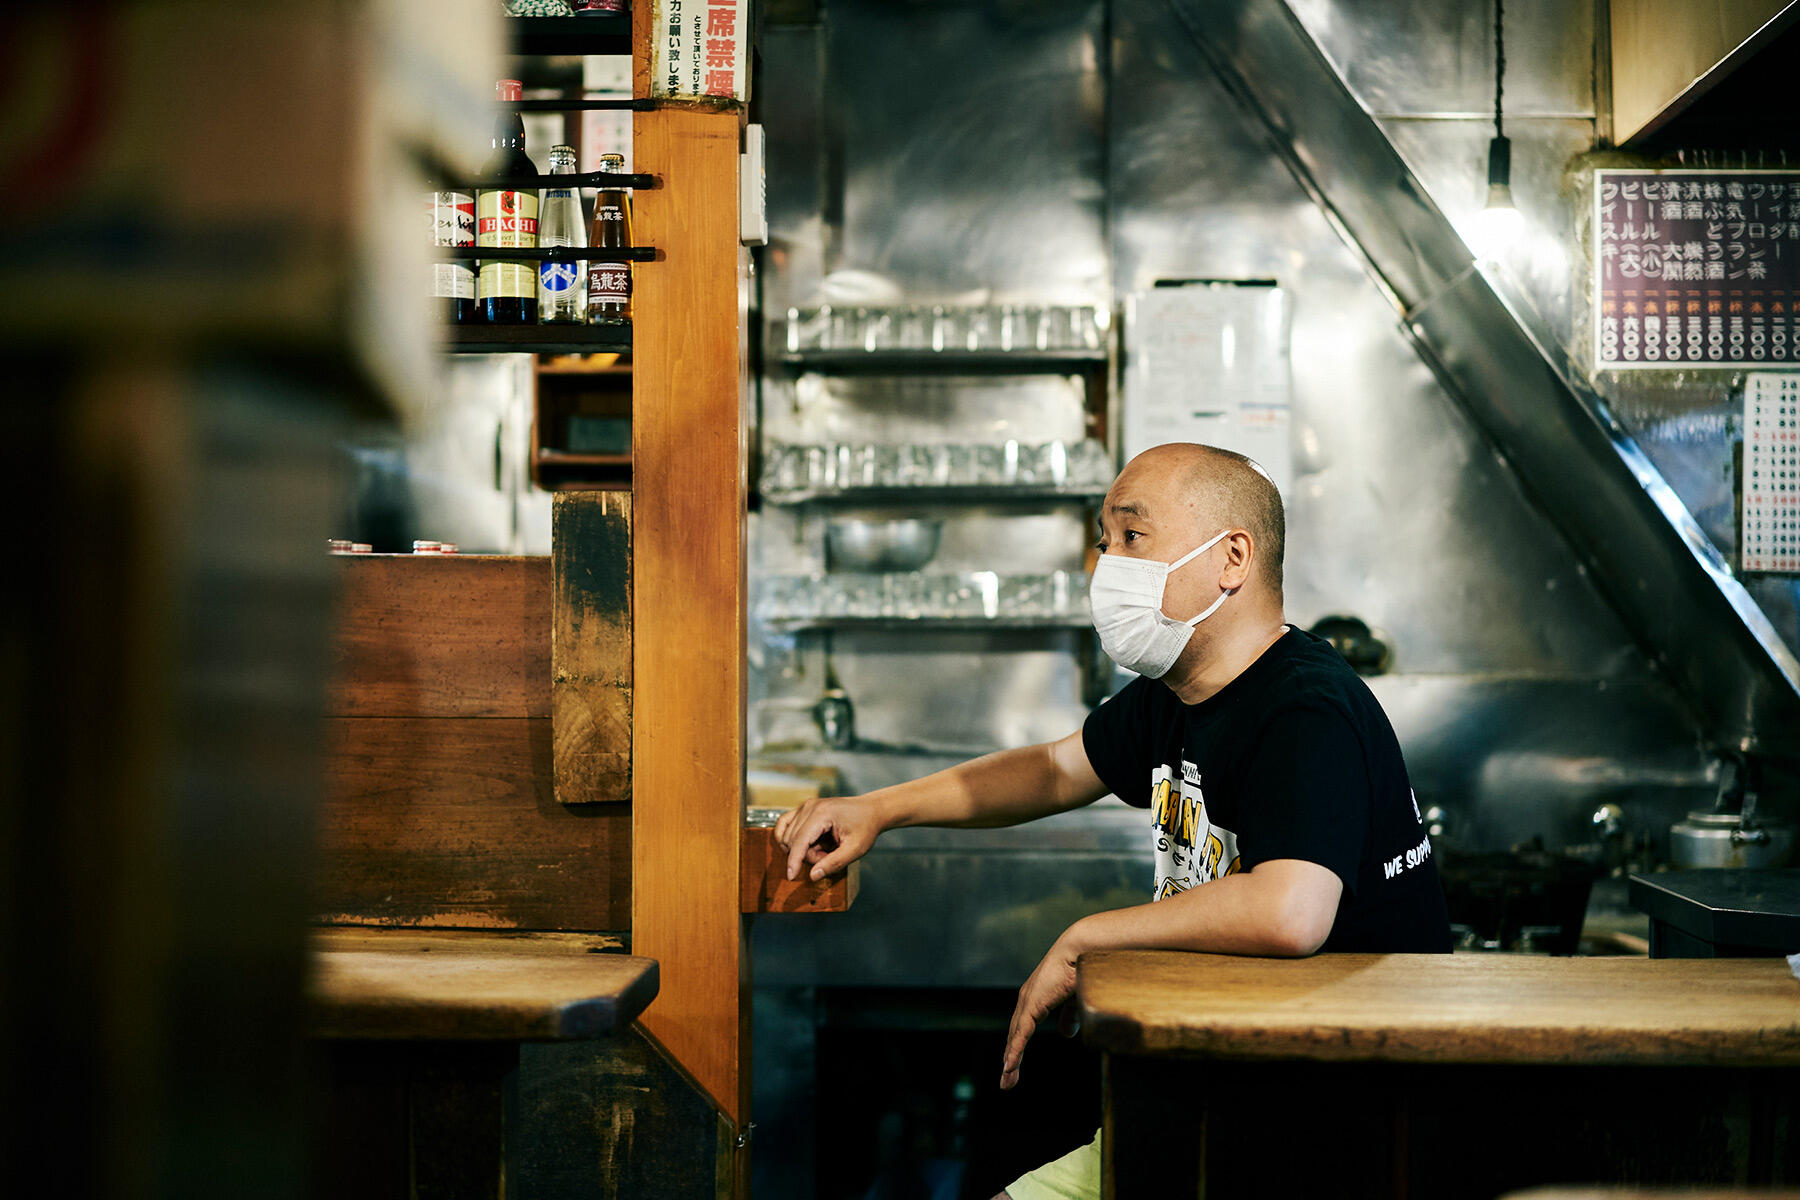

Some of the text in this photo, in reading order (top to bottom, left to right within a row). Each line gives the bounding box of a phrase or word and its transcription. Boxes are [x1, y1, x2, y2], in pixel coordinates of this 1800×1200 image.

[486, 218, 534, 232] HACHI
[590, 272, 628, 291] 烏龍茶
[1383, 855, 1403, 879] WE
